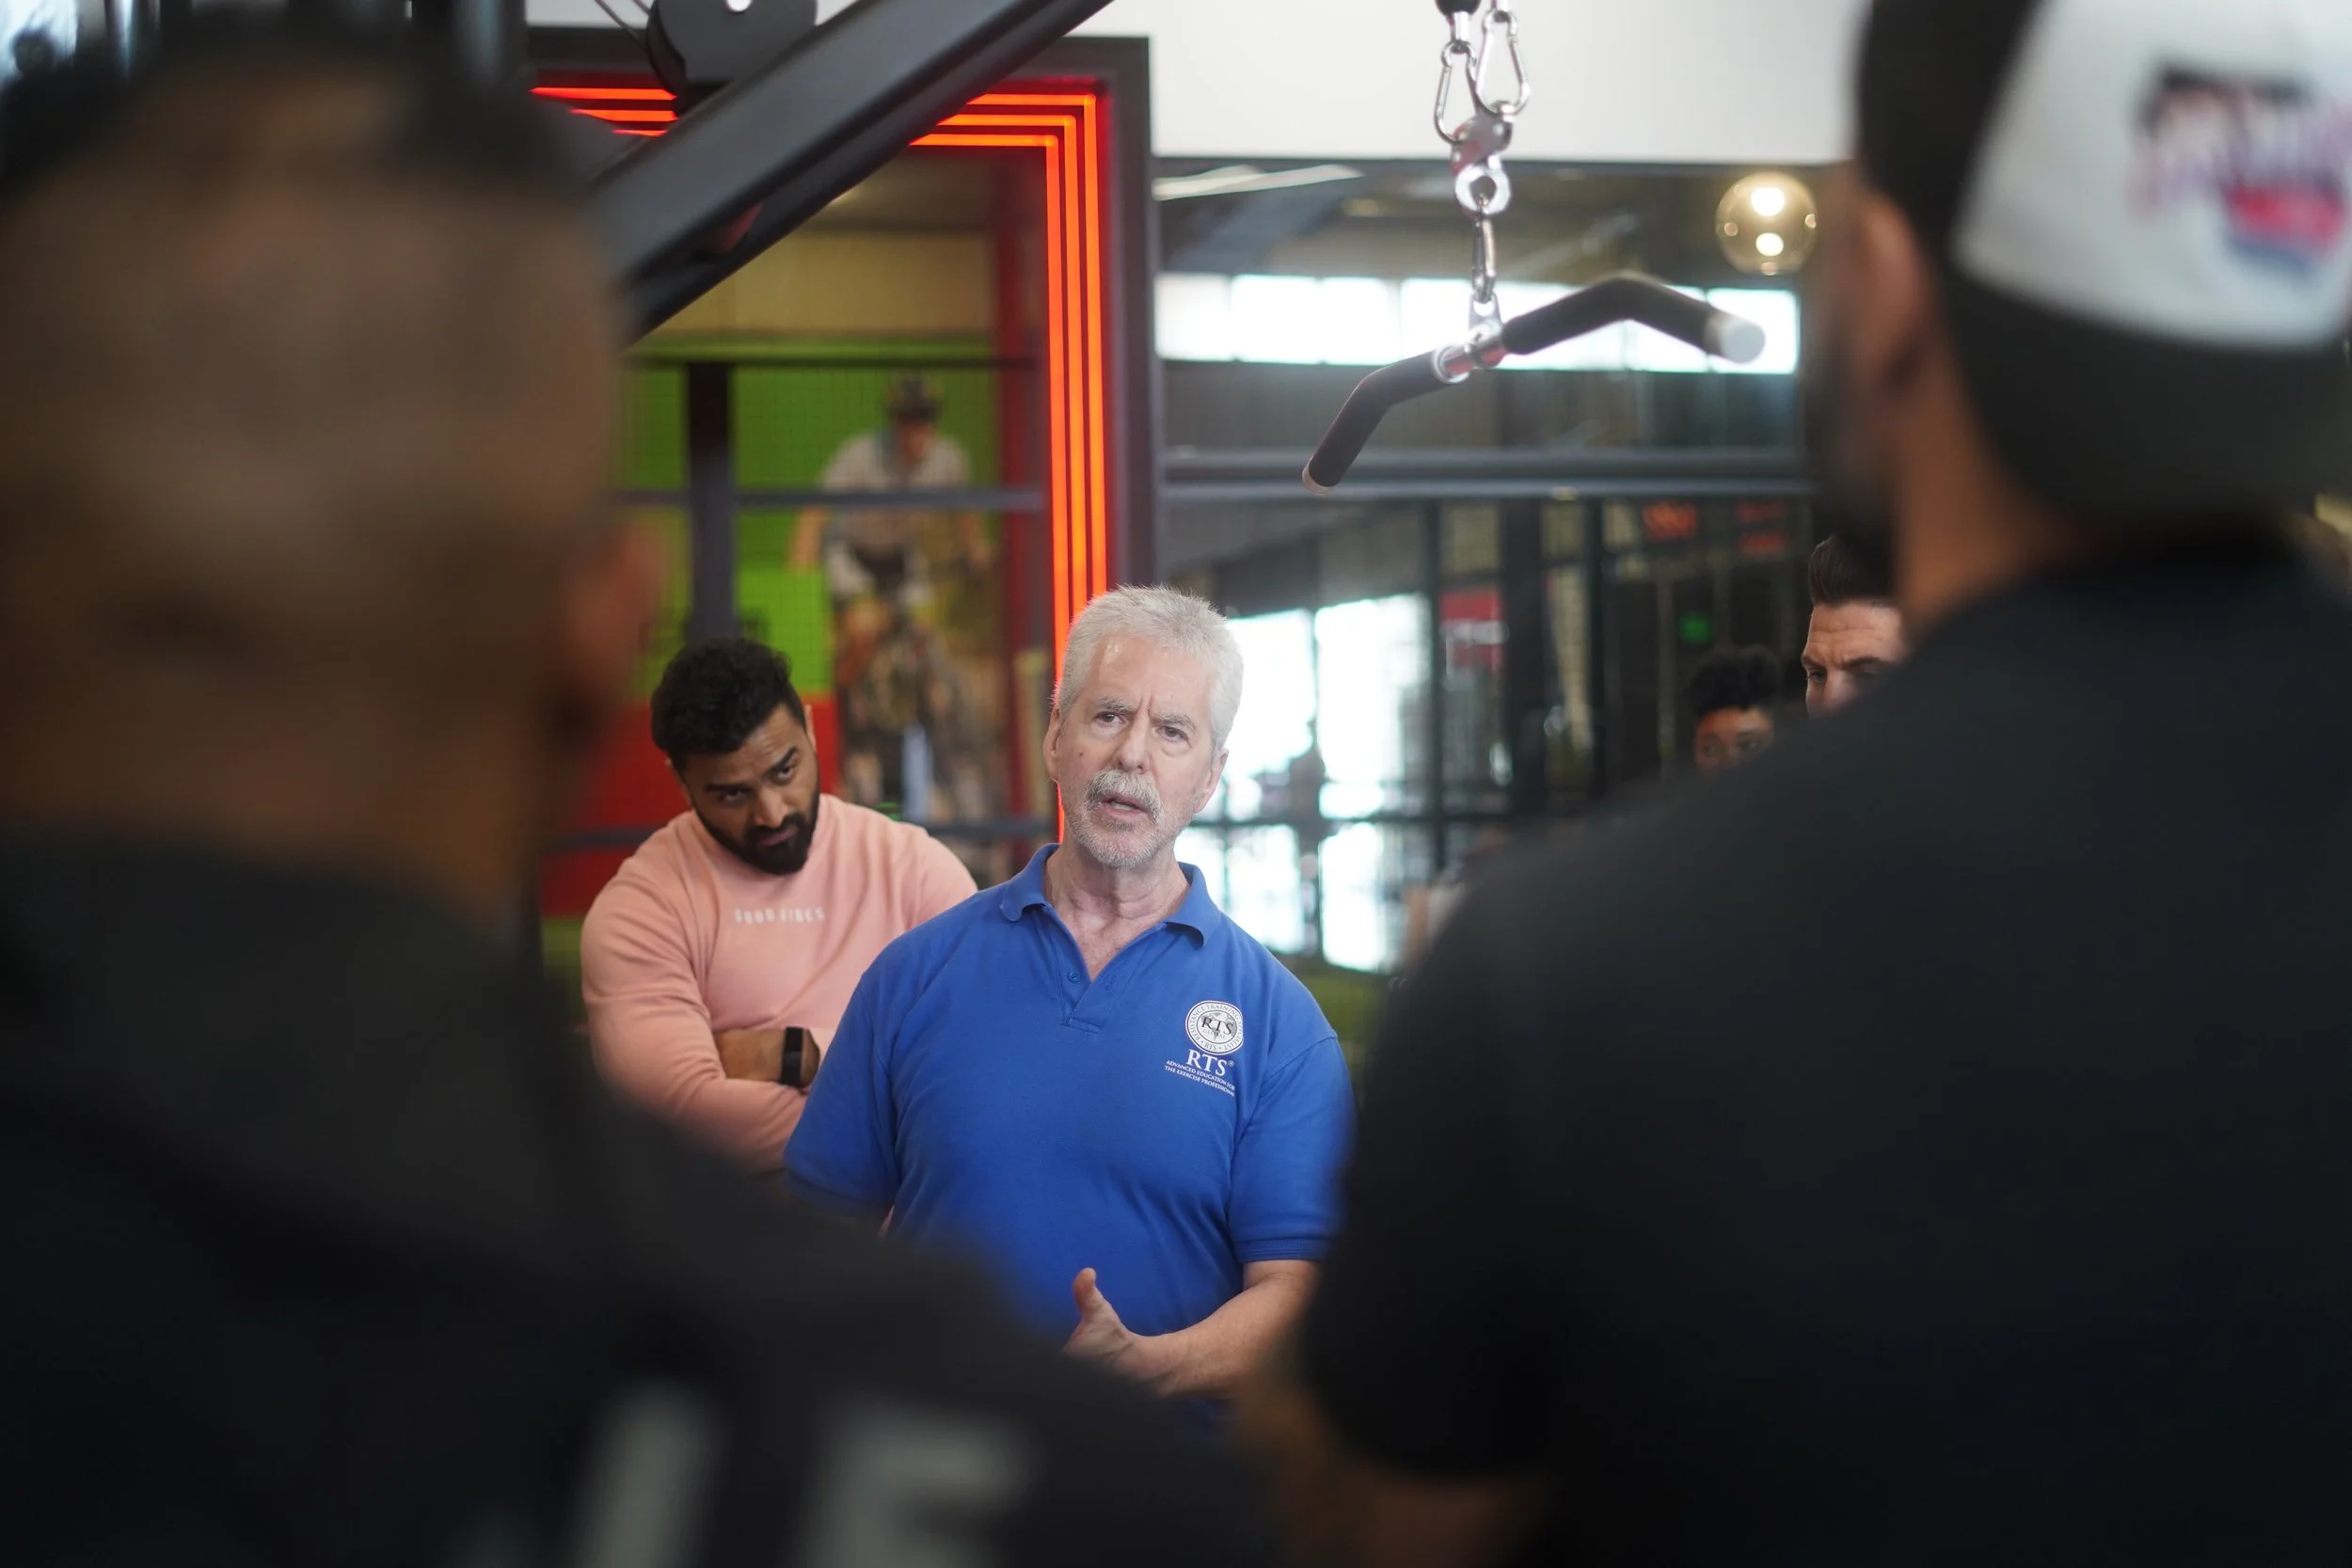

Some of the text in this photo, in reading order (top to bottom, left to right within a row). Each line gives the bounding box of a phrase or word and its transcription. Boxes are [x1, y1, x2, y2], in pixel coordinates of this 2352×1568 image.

[1201, 1017, 1233, 1035] RTS
[1204, 1042, 1217, 1051] RTS
[1166, 1060, 1235, 1091] ADVANCED EDUCATION FOR
[1176, 1069, 1200, 1083] EXERCISE
[1201, 1079, 1235, 1097] PROFESSIONAL
